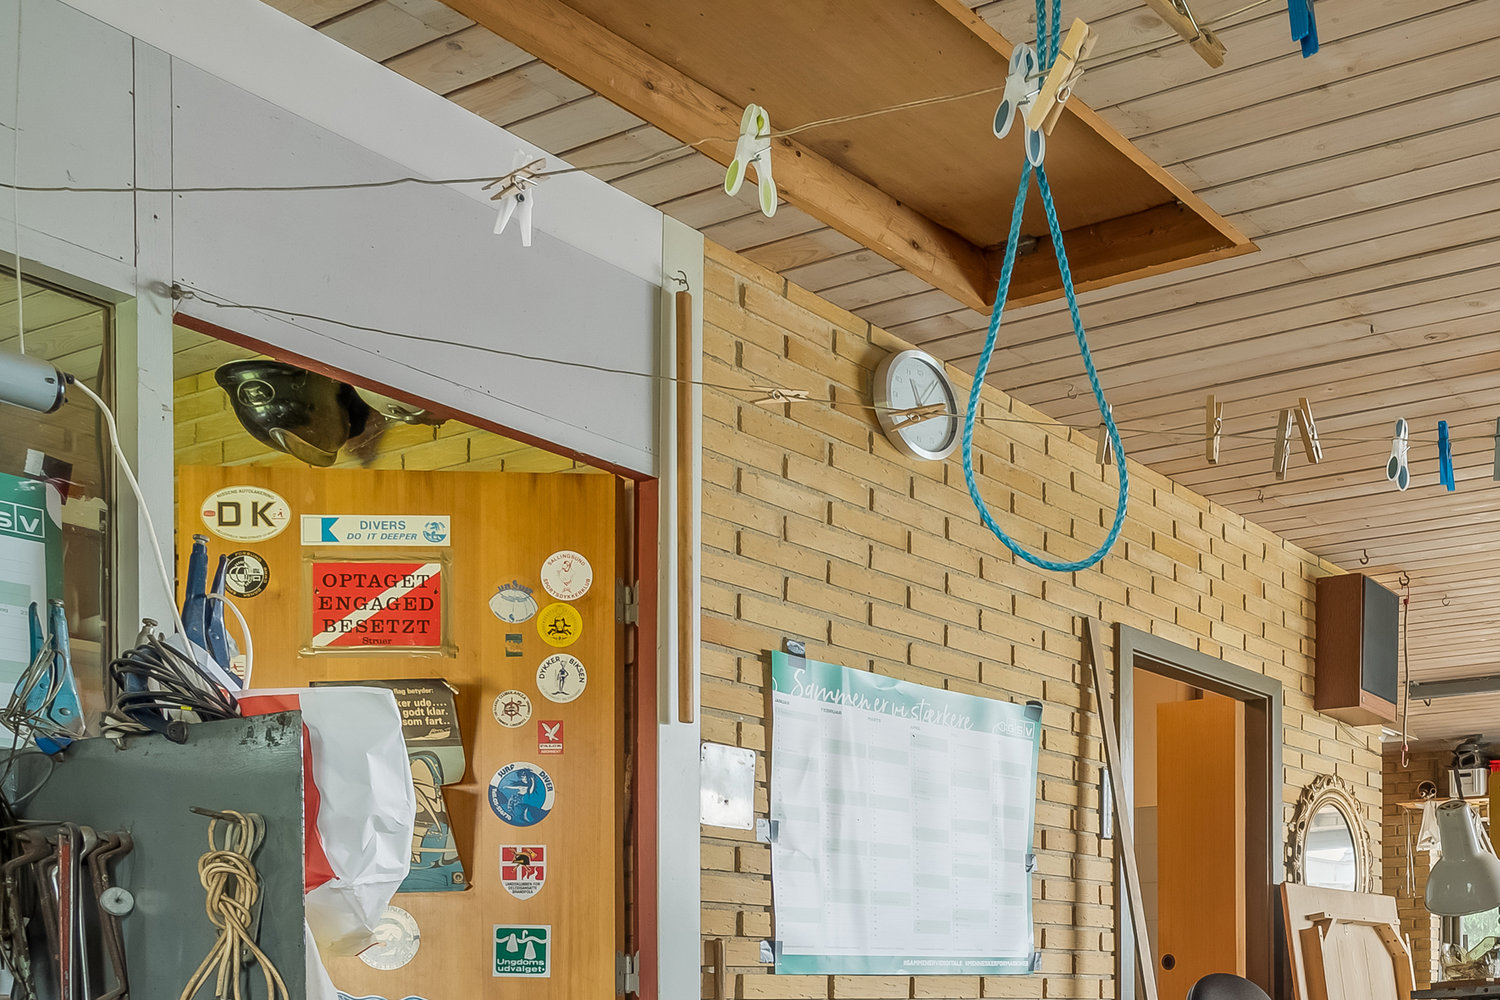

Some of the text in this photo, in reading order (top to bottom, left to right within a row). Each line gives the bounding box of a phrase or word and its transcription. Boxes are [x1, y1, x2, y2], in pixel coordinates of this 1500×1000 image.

[359, 520, 406, 530] DIVERS
[346, 532, 418, 541] DO IT DEEPER
[547, 553, 586, 567] SALLINGSUND
[322, 573, 430, 588] OPTAGET
[318, 596, 434, 611] ENGAGED
[322, 619, 430, 634] BESETZT
[361, 636, 392, 645] Struer
[539, 655, 585, 683] DYKKER BIKSEN
[406, 687, 434, 696] betyder:
[790, 668, 974, 731] Sammen er vi stærkere
[402, 707, 449, 717] godt klar.
[497, 763, 554, 792] SURF DIVER
[496, 958, 545, 966] Ungdoms
